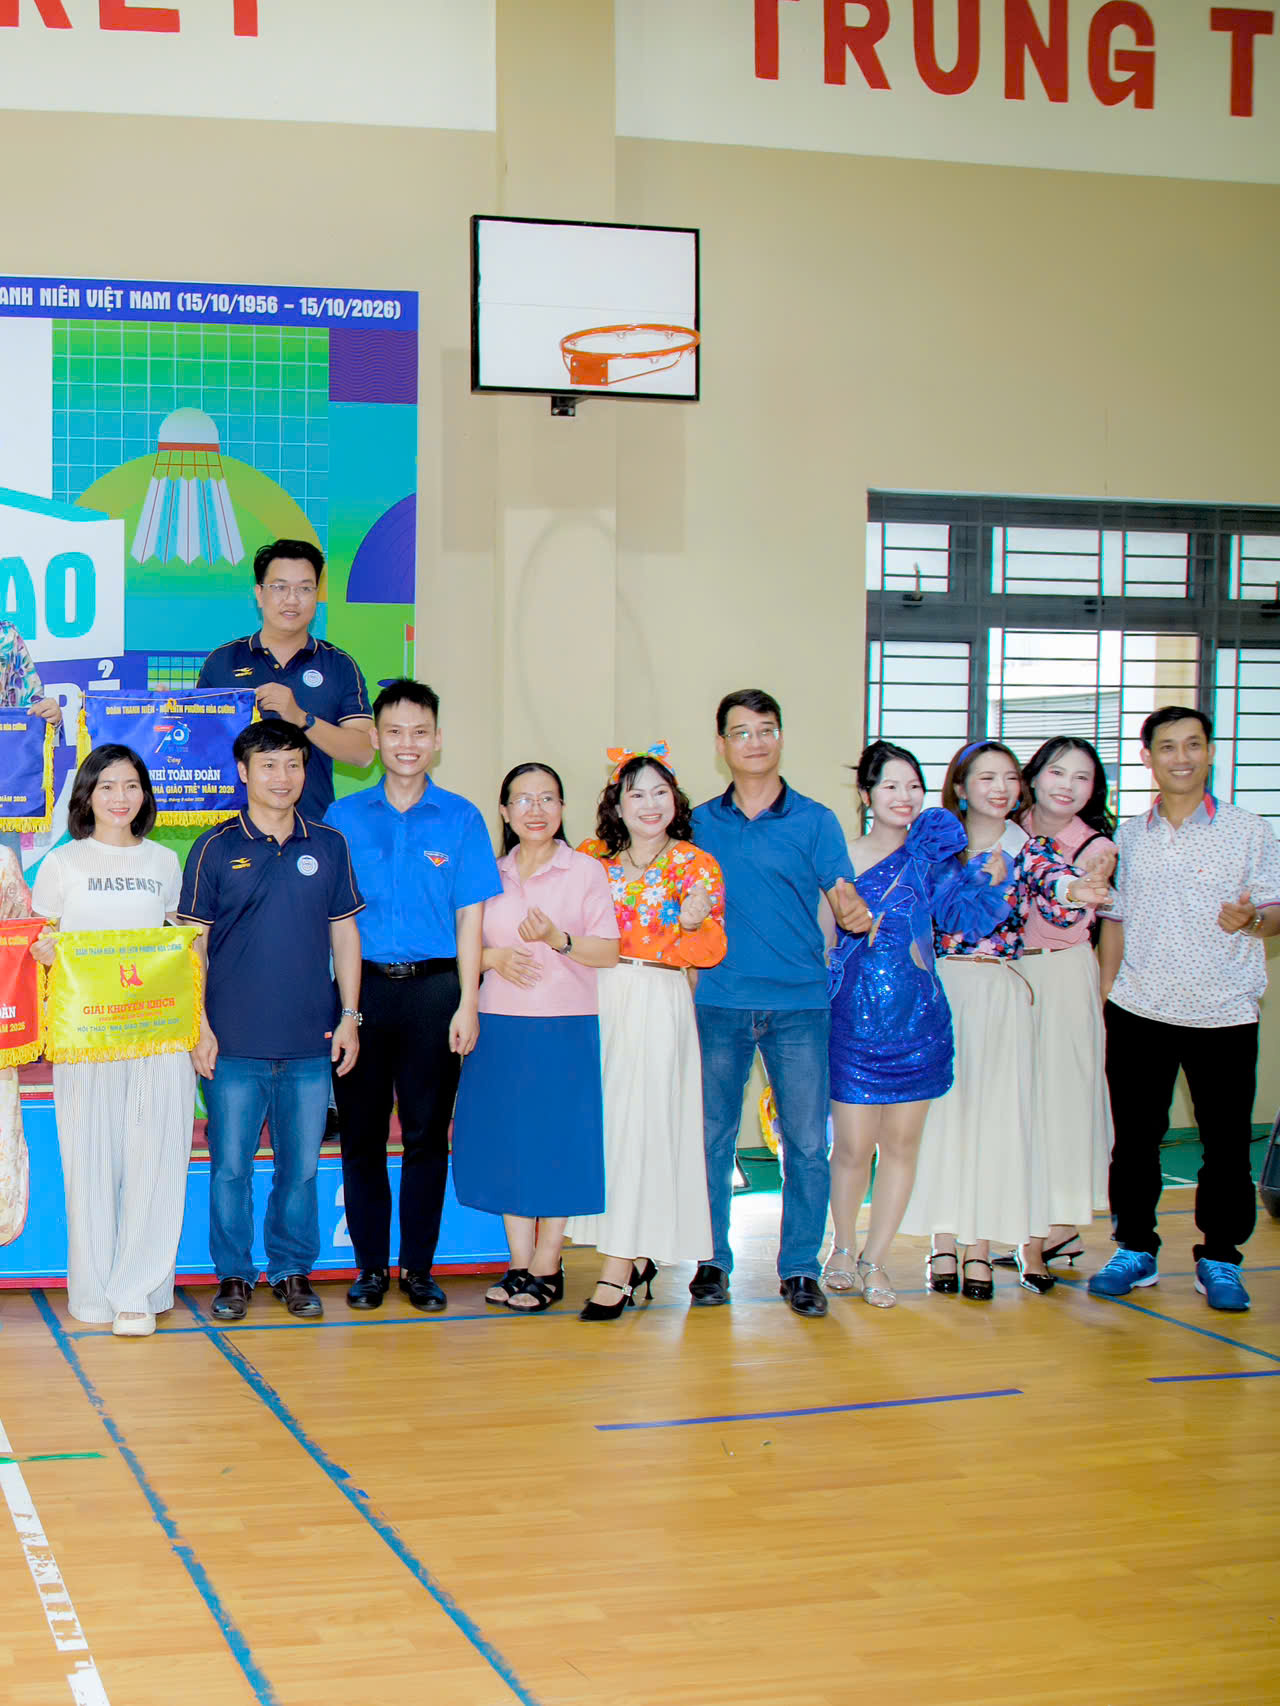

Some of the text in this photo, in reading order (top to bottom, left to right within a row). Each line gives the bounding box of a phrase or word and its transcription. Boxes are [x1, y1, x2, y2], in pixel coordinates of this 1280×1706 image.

[39, 284, 80, 308] NIÊN
[86, 286, 124, 313] VIỆT
[129, 290, 171, 311] NAM
[177, 292, 278, 315] (15/10/1956
[299, 297, 401, 320] 15/10/2026)
[167, 765, 193, 781] TOÀN
[194, 765, 221, 781] ĐOÀN
